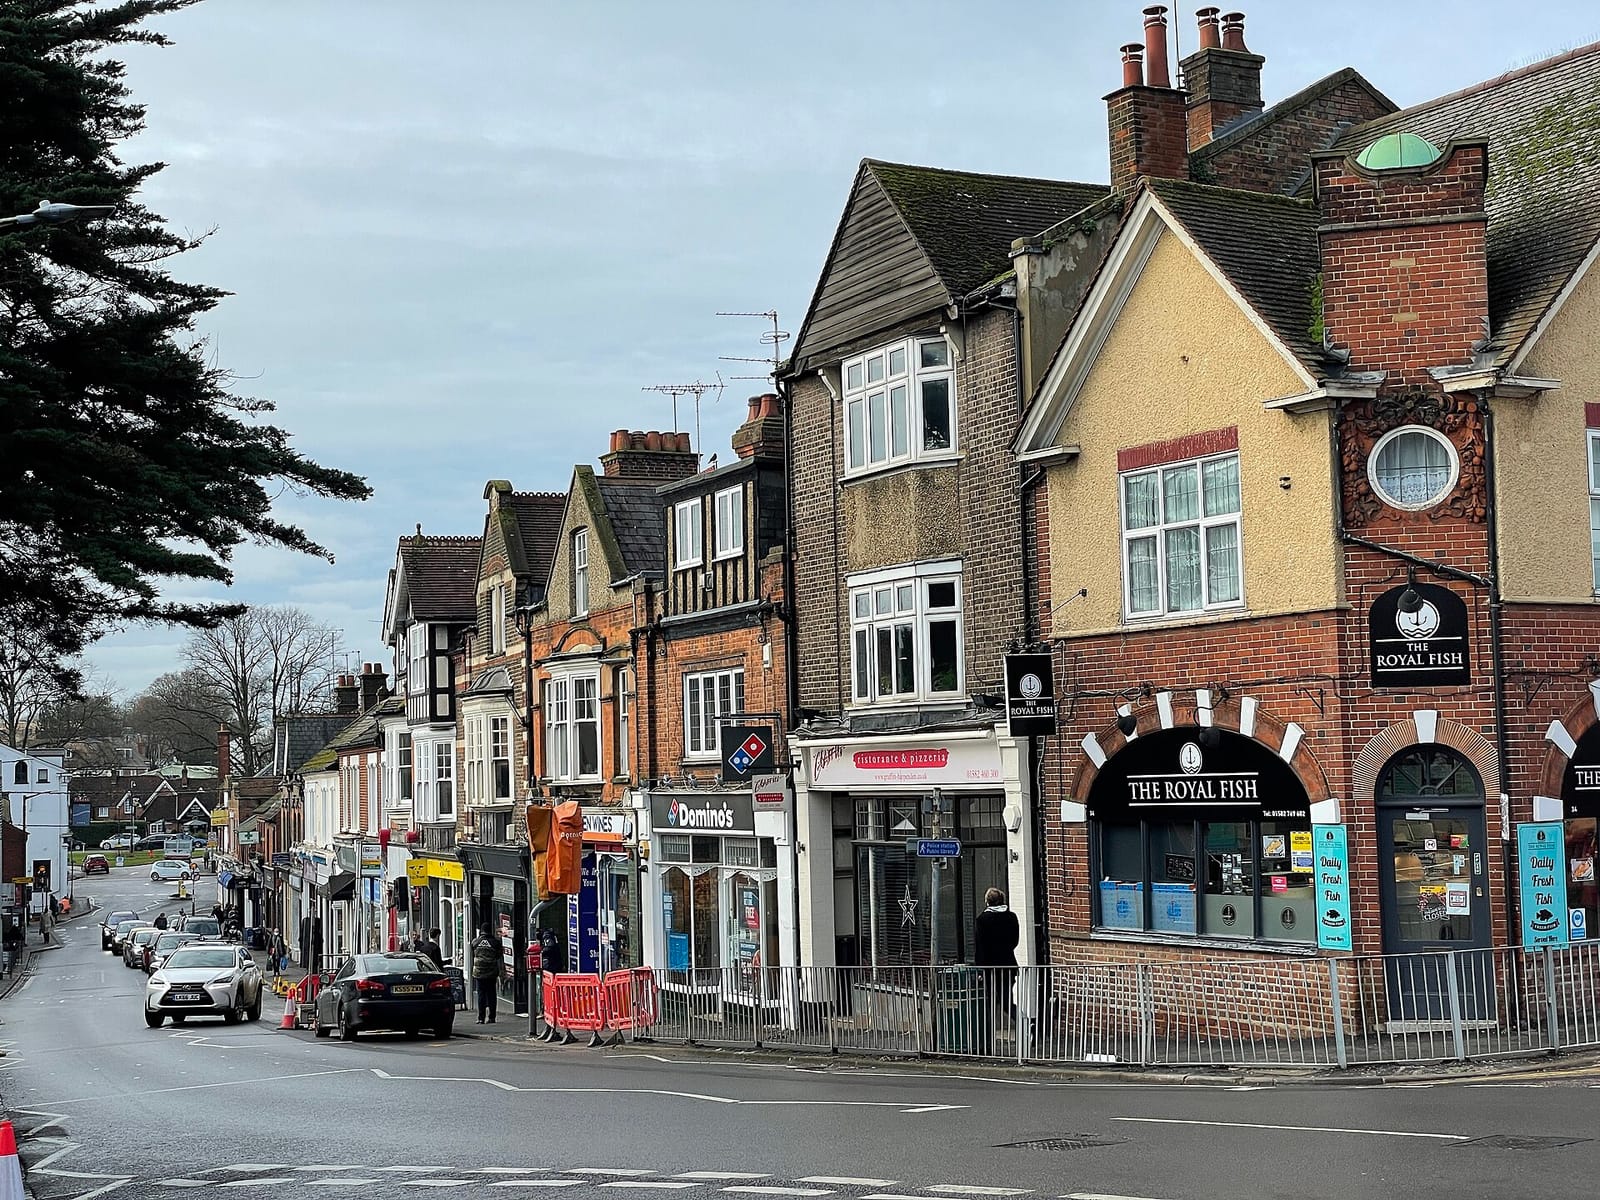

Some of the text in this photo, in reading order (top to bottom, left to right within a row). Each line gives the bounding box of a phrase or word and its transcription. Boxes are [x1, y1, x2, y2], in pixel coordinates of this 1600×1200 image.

[1406, 643, 1429, 652] THE
[1376, 652, 1463, 667] ROYAL FISH
[1011, 706, 1054, 715] ROYAL FISH
[857, 750, 946, 766] ristorante & pizzeria
[1575, 770, 1600, 785] THE
[1128, 779, 1259, 800] THE ROYAL FISH
[679, 801, 734, 828] Domino's
[583, 816, 613, 833] EN WINES
[1320, 856, 1342, 870] Daily
[1530, 856, 1554, 871] Daily
[582, 878, 596, 887] Your
[1322, 873, 1342, 885] Fresh
[1531, 874, 1554, 887] Fresh
[1325, 890, 1341, 902] Fish
[1535, 892, 1553, 905] Fish
[587, 927, 599, 936] Tha
